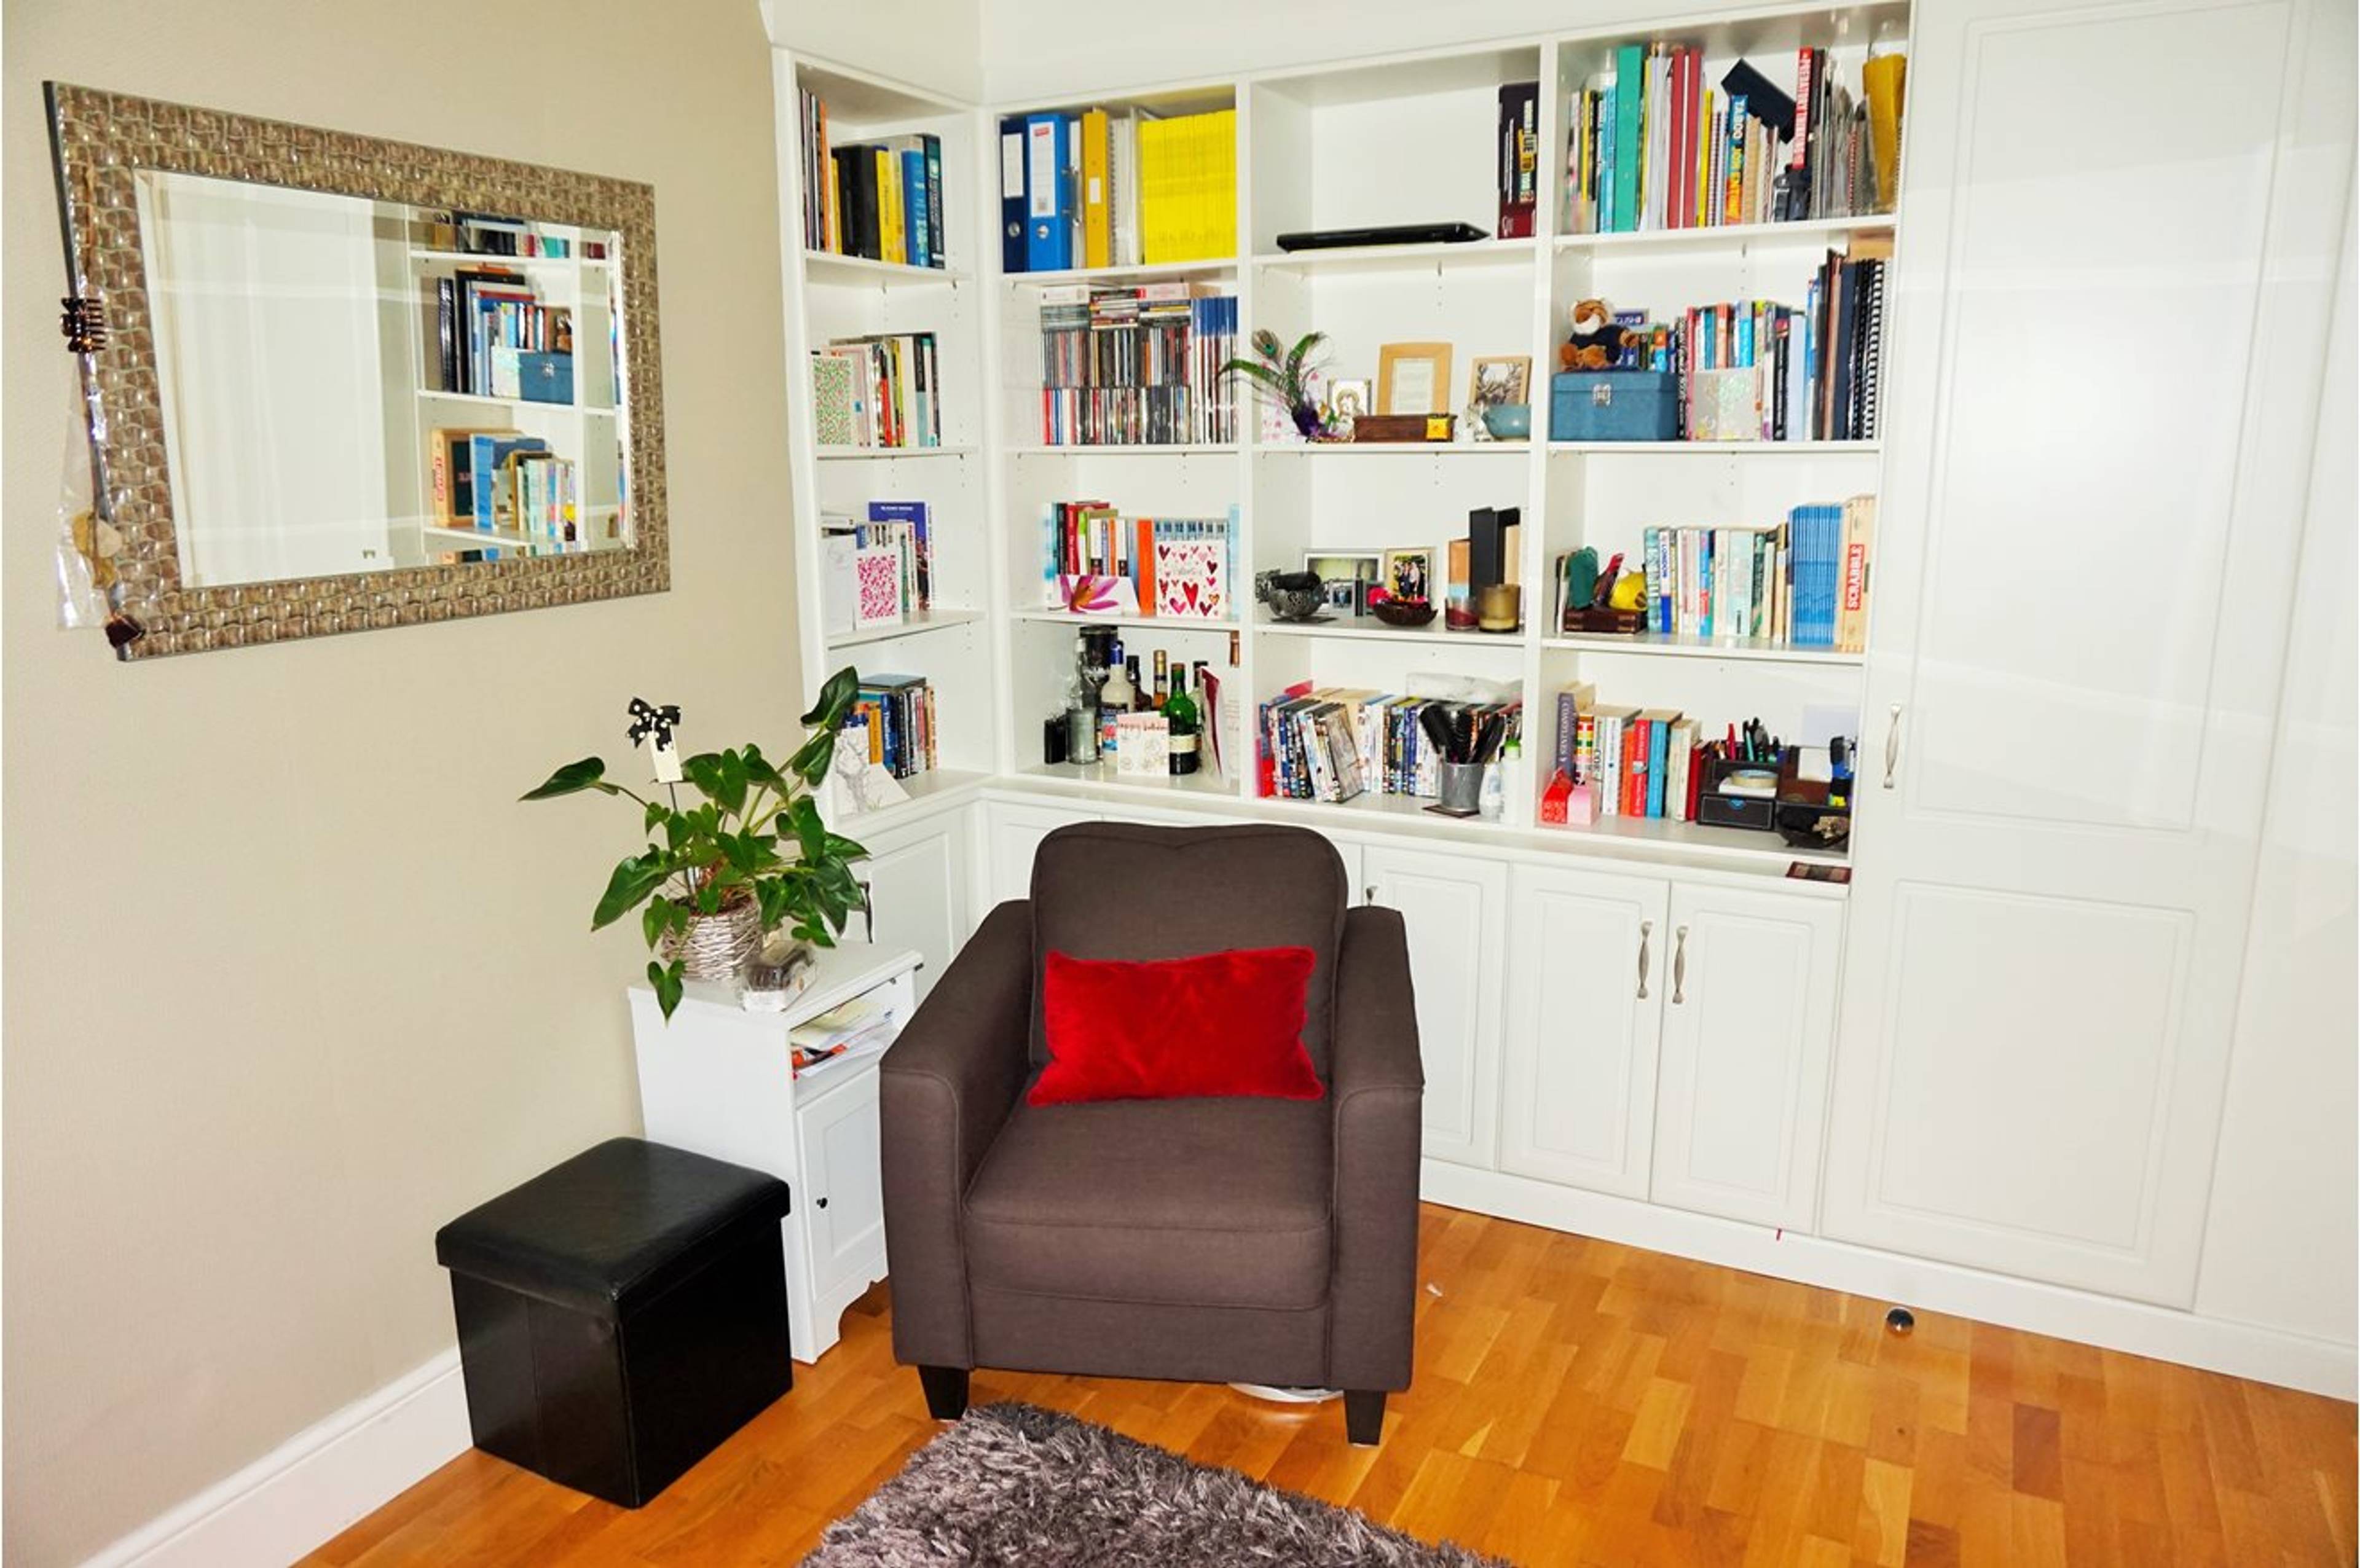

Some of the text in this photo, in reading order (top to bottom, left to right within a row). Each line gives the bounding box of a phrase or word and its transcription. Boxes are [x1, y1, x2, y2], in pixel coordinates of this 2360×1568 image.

[1733, 98, 1745, 139] TABOO
[1524, 137, 1535, 153] LIE
[1847, 545, 1863, 608] SCRABBLE
